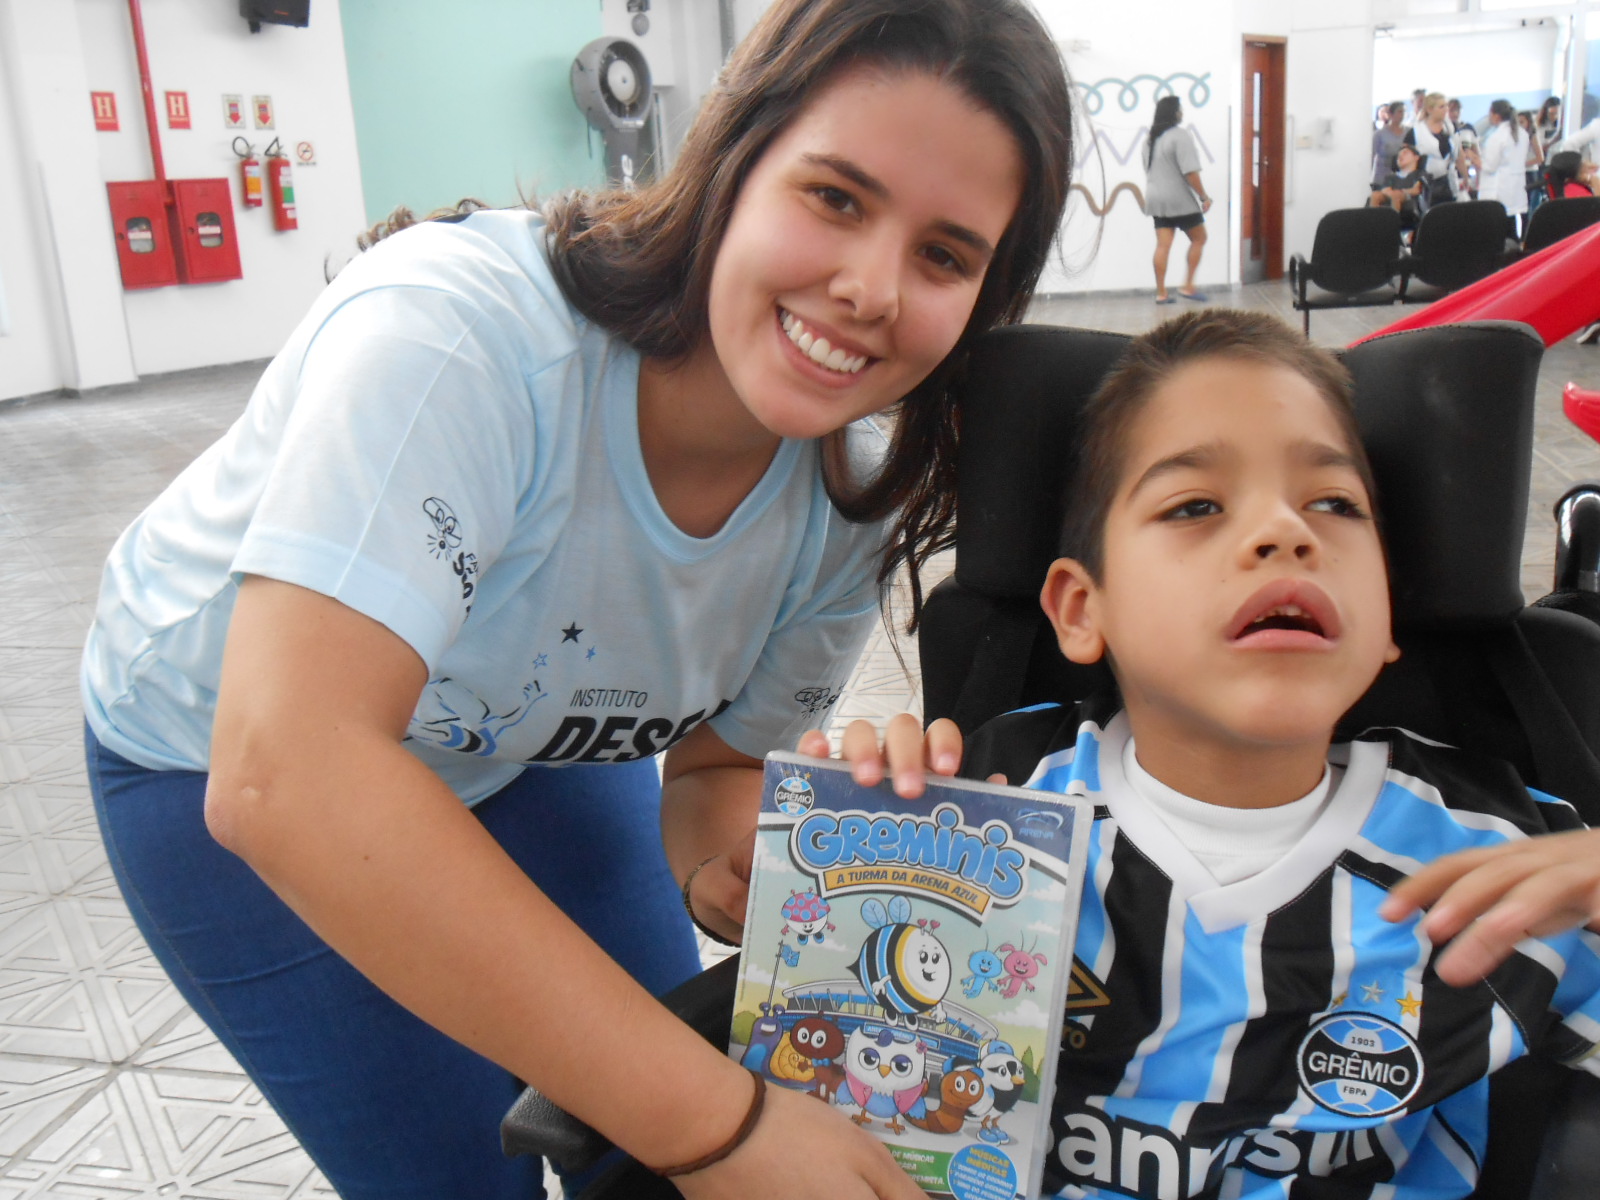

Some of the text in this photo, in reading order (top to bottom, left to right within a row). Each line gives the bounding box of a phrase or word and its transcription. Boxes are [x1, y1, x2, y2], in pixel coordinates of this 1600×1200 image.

[95, 96, 112, 118] H
[169, 94, 186, 116] H
[569, 688, 648, 709] INSTITUTO
[836, 870, 979, 904] A TURMA DA ARENA AZUL
[1351, 1036, 1376, 1048] 1903
[1308, 1051, 1411, 1086] GRÊMIO
[1343, 1085, 1367, 1097] FBPA
